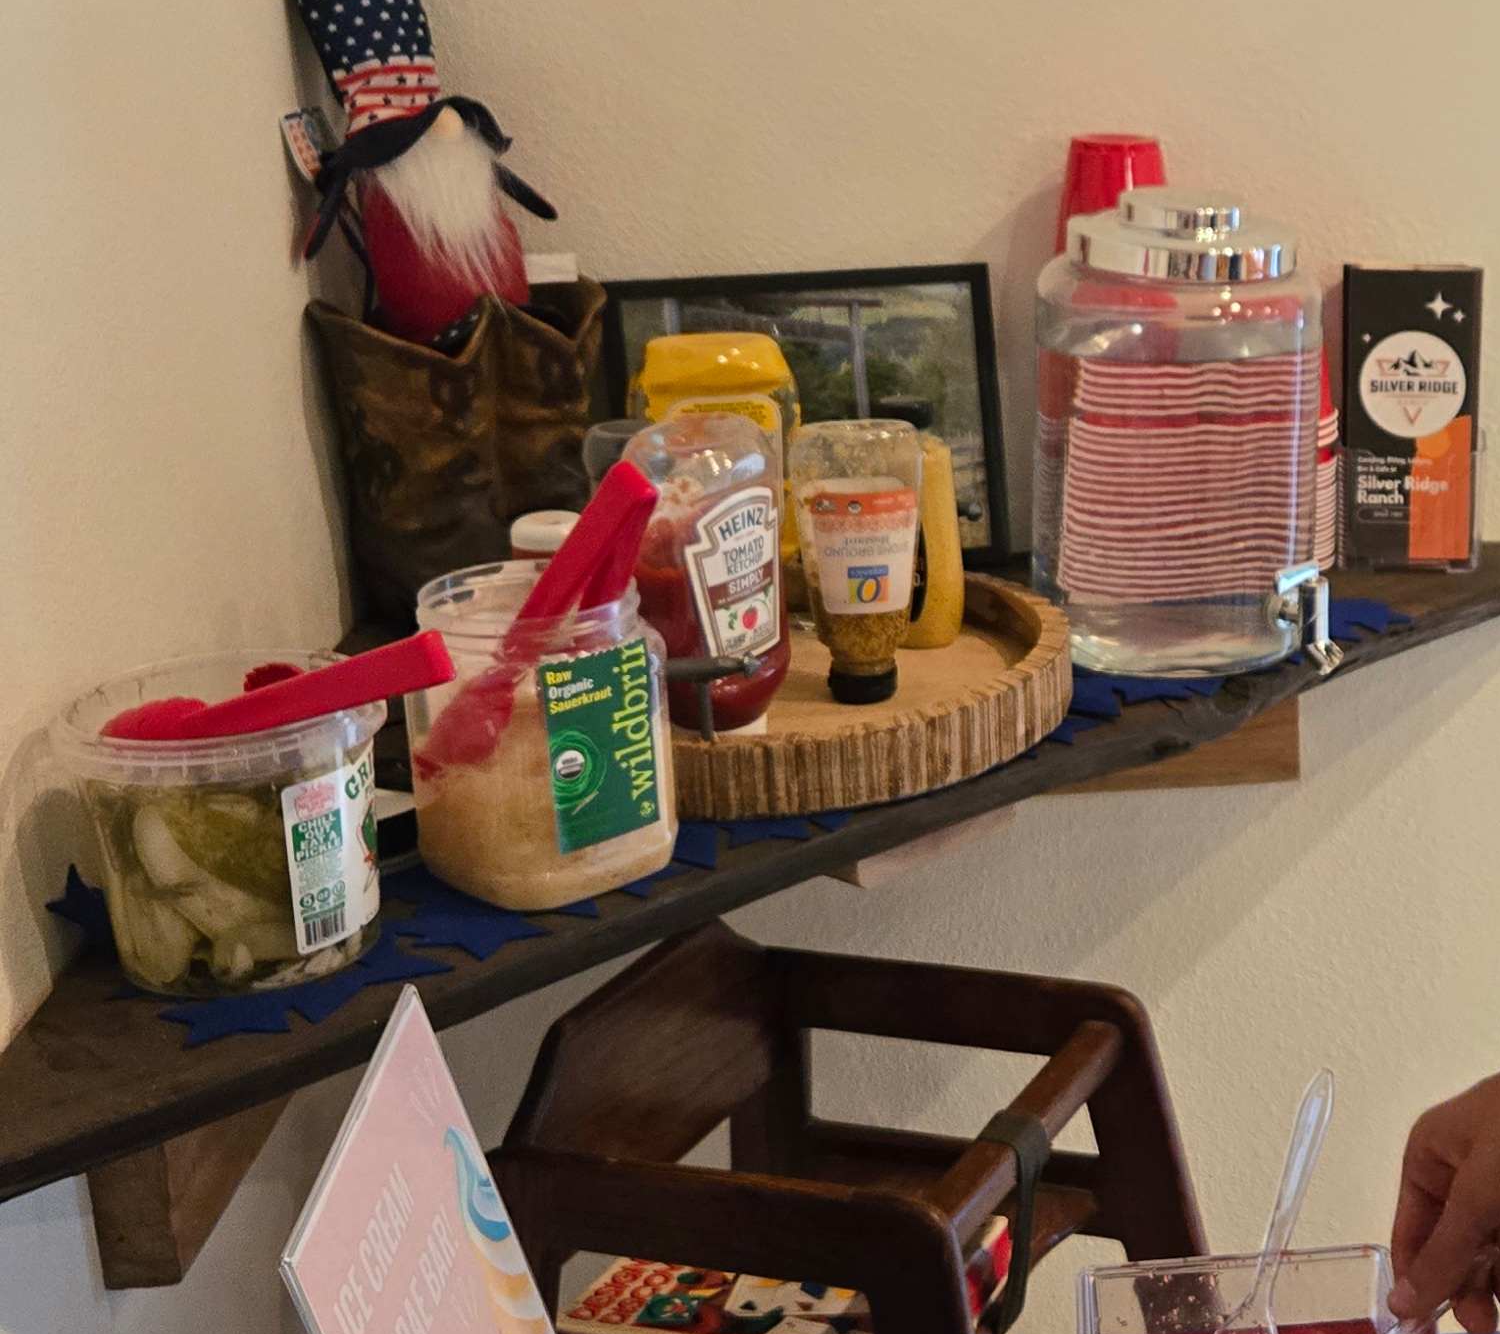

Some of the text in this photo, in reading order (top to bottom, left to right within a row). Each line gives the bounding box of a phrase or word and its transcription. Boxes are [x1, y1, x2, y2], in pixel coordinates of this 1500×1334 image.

[1370, 379, 1458, 394] SILVER RIDGE
[1358, 475, 1449, 495] Silver Ridge
[1358, 489, 1404, 504] Ranch
[718, 506, 765, 541] HEINZ
[722, 536, 765, 566] TOMATO
[727, 552, 764, 578] KETCHUP
[727, 568, 765, 595] SIMPLY
[546, 670, 572, 685] Raw
[548, 677, 595, 701] Organic
[549, 685, 613, 716] Sauerkraut
[298, 814, 337, 834] CHILL
[296, 839, 341, 863] PICKLE
[358, 1161, 415, 1296] CREAM
[418, 1204, 460, 1307] BAR!
